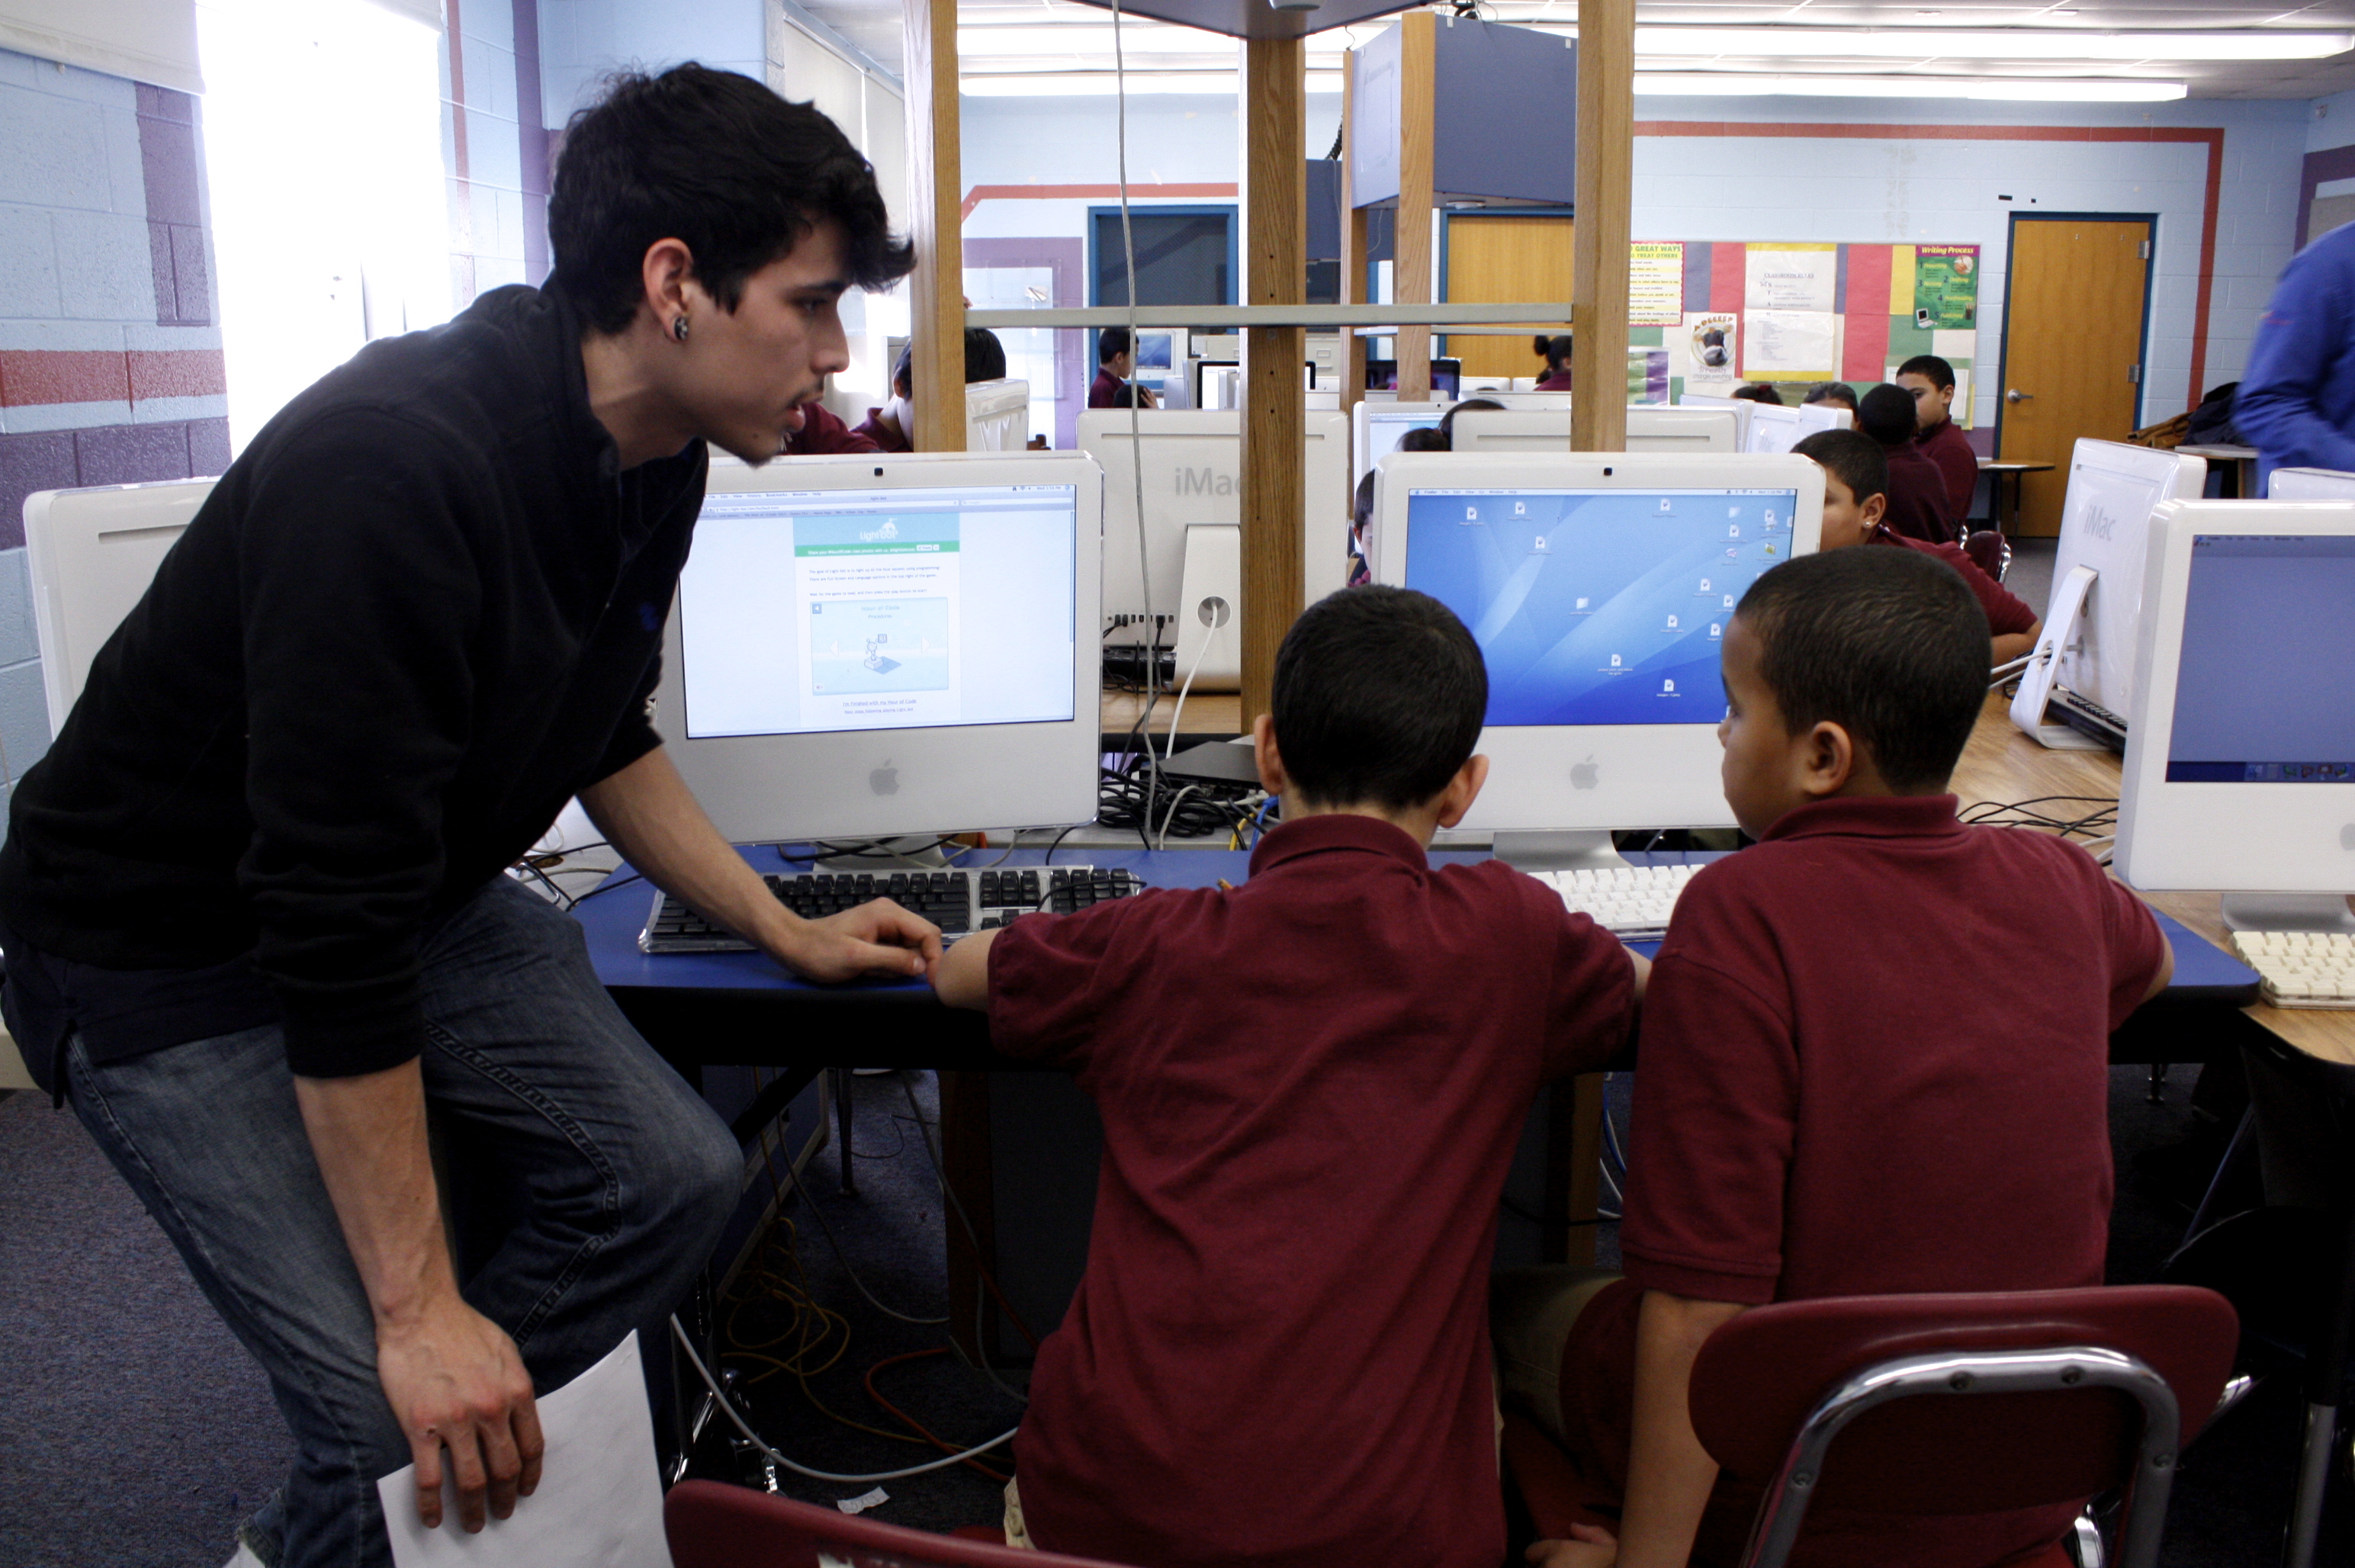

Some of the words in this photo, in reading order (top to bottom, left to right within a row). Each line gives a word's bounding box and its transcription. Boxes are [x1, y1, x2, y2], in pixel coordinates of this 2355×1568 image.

[1922, 246, 1947, 255] Writing
[1175, 468, 1240, 496] iMa
[2084, 504, 2116, 541] iMac
